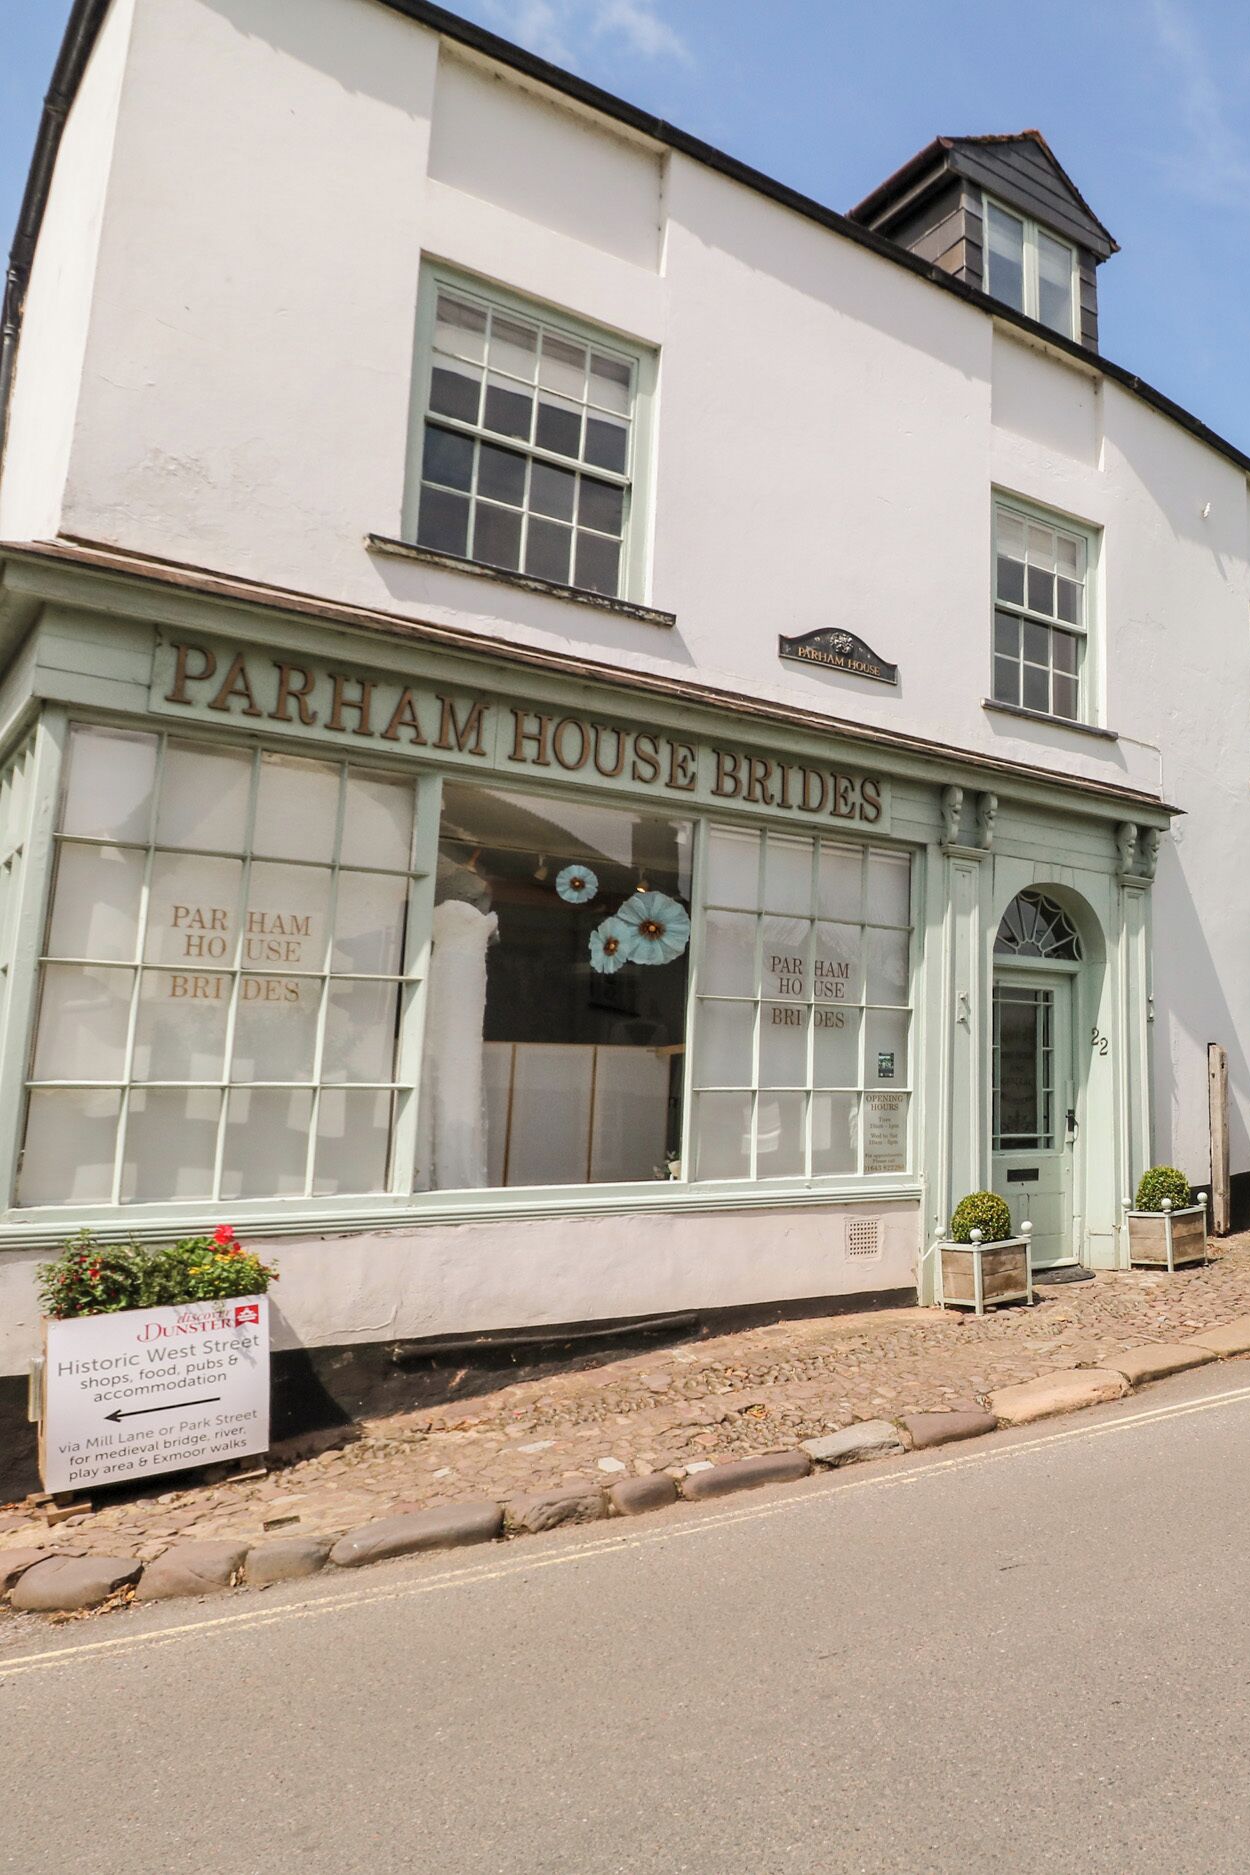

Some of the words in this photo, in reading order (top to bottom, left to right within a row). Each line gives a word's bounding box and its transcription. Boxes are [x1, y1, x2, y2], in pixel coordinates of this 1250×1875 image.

[798, 646, 844, 666] PARHAM
[848, 660, 881, 676] HOUSE
[165, 641, 490, 755] PARHAM
[508, 708, 697, 792] HOUSE
[711, 747, 882, 823] BRIDES
[1091, 1026, 1108, 1056] 22
[865, 1094, 904, 1103] OPENING
[871, 1103, 899, 1111] HOURS
[57, 1352, 140, 1377] Historic
[147, 1344, 196, 1362] West
[203, 1335, 259, 1354] Street
[80, 1371, 133, 1389] shops,
[186, 1358, 223, 1375] pubs
[228, 1354, 238, 1365] &
[93, 1372, 227, 1402] accommodation
[58, 1442, 81, 1454] via
[86, 1434, 113, 1449] Mill
[118, 1430, 154, 1444] Lane
[159, 1426, 174, 1437] or
[179, 1417, 211, 1432] Park
[215, 1409, 258, 1426] Street
[68, 1466, 99, 1482] play
[103, 1461, 134, 1474] area
[138, 1457, 148, 1467] &
[153, 1448, 207, 1464] Exmoor
[211, 1438, 247, 1453] walks
[69, 1455, 90, 1466] for
[95, 1441, 159, 1462] medieval
